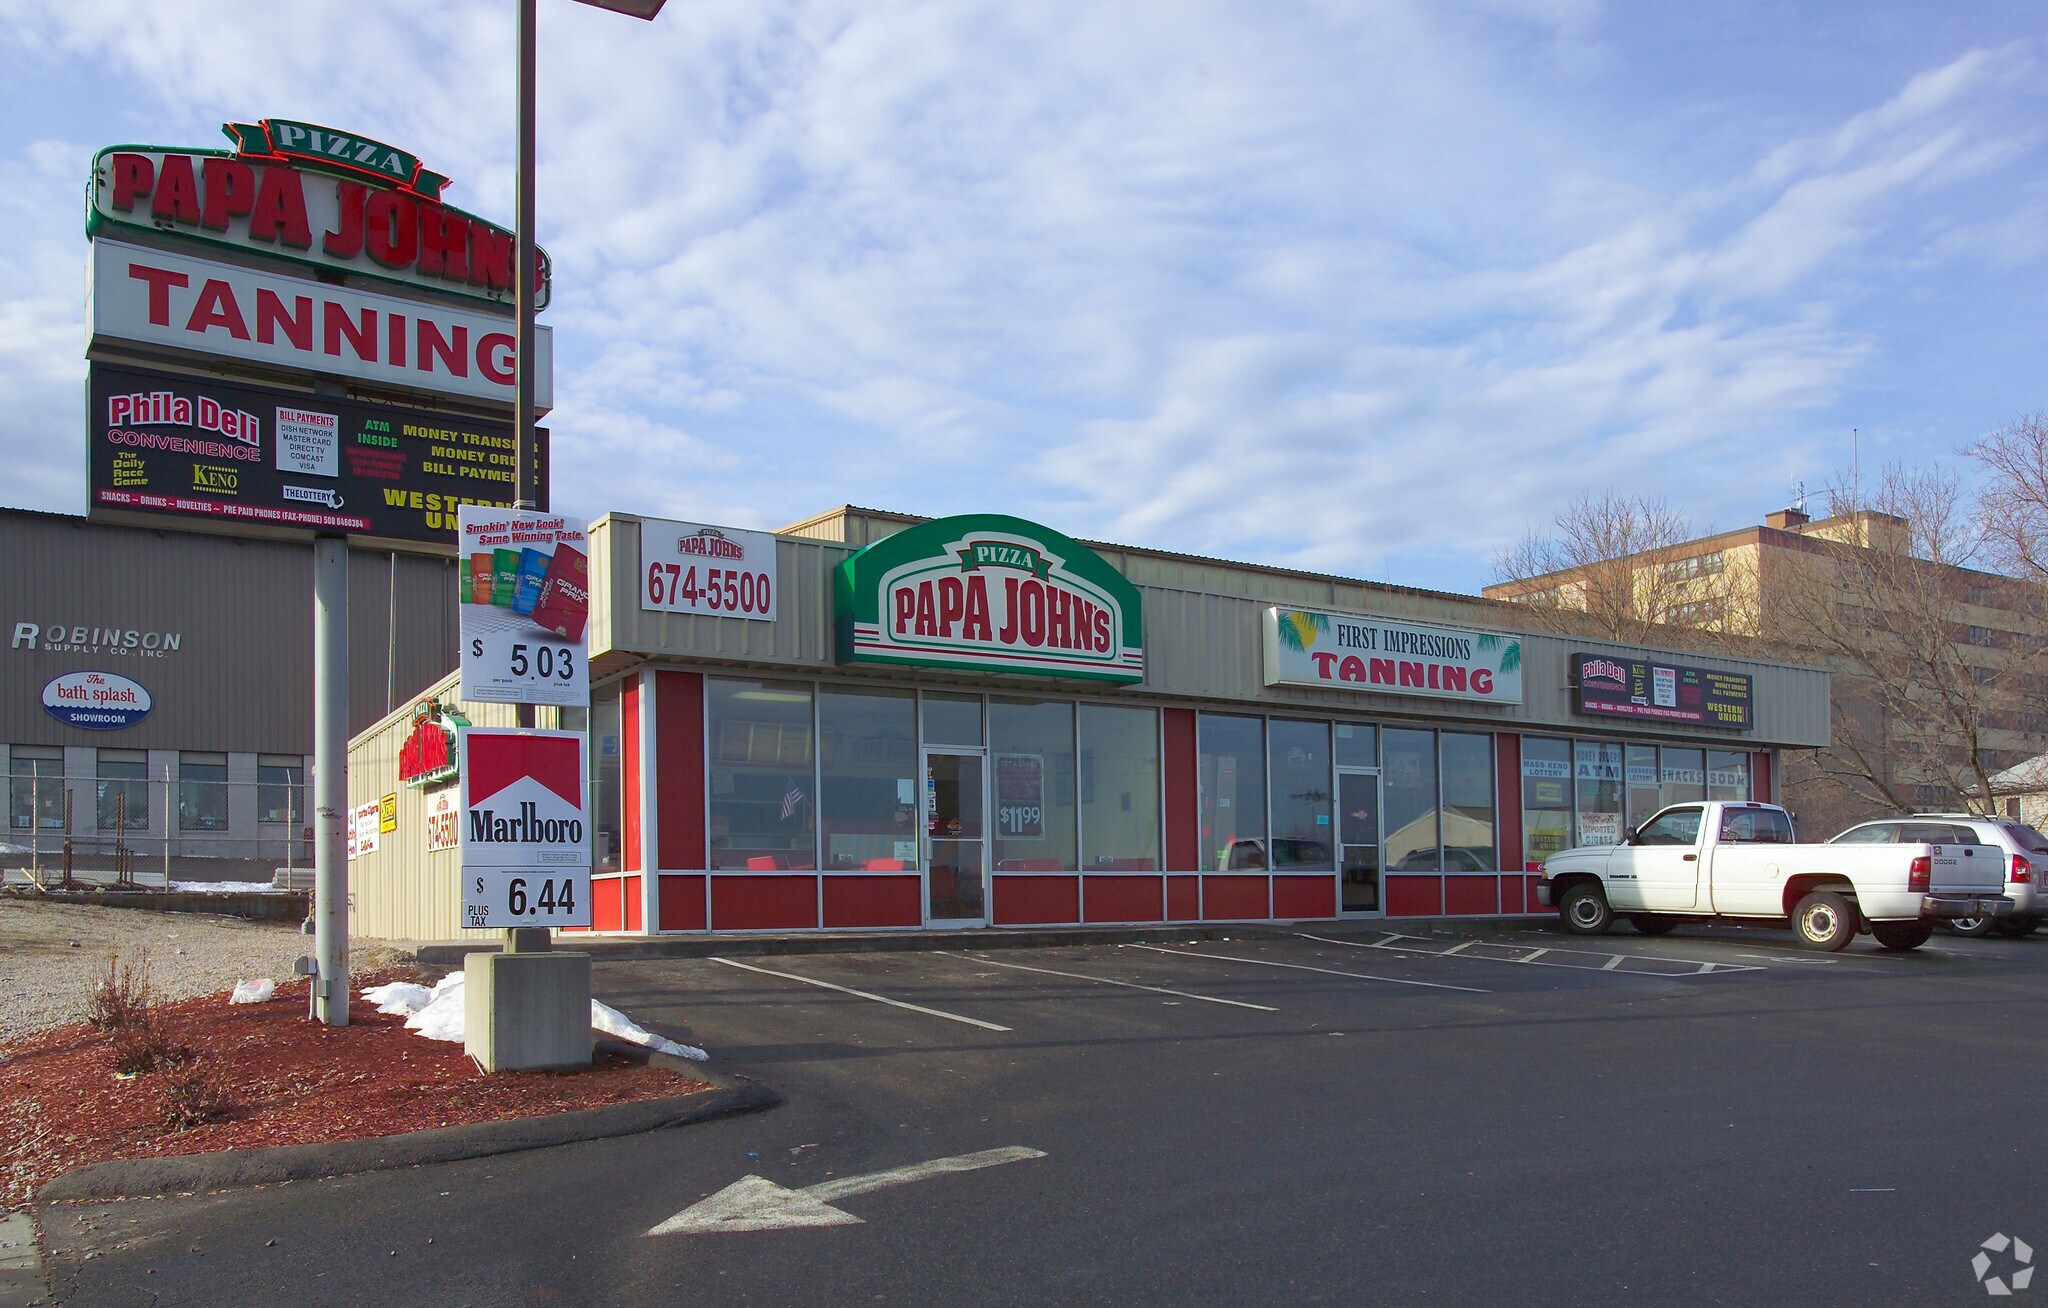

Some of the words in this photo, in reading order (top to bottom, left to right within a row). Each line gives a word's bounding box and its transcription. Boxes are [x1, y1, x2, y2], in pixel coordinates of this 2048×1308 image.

[278, 122, 405, 176] PIZZA
[112, 153, 312, 251] PAPA
[128, 263, 516, 385] TANNING
[109, 392, 192, 427] Phila
[198, 396, 260, 446] Deli
[280, 411, 295, 421] BILL
[297, 413, 334, 427] PAYMENTS
[365, 420, 390, 432] ATM
[281, 424, 298, 433] DISH
[299, 427, 333, 438] NETWORK
[403, 425, 459, 442] MONEY
[108, 428, 261, 462] CONVENIENCE
[283, 434, 311, 444] MASTER
[312, 437, 331, 446] CARD
[357, 433, 398, 448] INSIDE
[290, 443, 314, 453] DIRECT
[431, 446, 486, 462] MONEY
[113, 460, 145, 469] Daily
[290, 453, 324, 462] COMCAST
[113, 469, 144, 477] Race
[300, 462, 315, 470] VISA
[423, 462, 455, 476] BILL
[113, 478, 149, 487] Game
[193, 464, 238, 488] KENO
[101, 491, 130, 503] SNACKS
[140, 495, 167, 507] DRINKS
[176, 499, 212, 512] NOVELTIES
[223, 505, 236, 515] PRE
[238, 506, 253, 517] PAID
[255, 508, 281, 520] PHONES
[511, 520, 535, 532] New
[536, 518, 565, 530] Look!
[479, 534, 509, 546] Same
[512, 531, 553, 545] Winning
[680, 538, 707, 554] PAPA
[977, 546, 1034, 569] PIZZA
[560, 586, 583, 603] PRIX
[648, 561, 771, 615] 674-5500
[895, 575, 993, 641] PAPA
[1000, 577, 1110, 653] JOHN'S
[11, 622, 181, 651] ROBINSON
[1337, 624, 1378, 650] FIRST
[1383, 629, 1471, 661] IMPRESSIONS
[44, 642, 99, 654] SUPPLY
[140, 649, 168, 658] INC.
[472, 637, 483, 659] $
[510, 644, 574, 680] 5.03
[1311, 651, 1494, 695] TANNING
[1583, 660, 1606, 679] Phila
[86, 673, 105, 685] The
[57, 683, 90, 701] bath
[92, 687, 137, 706] splash
[1707, 702, 1742, 714] WESTERN
[70, 713, 126, 724] SHOWROOM
[1718, 712, 1743, 723] UNION
[1529, 769, 1563, 777] LOTTERY
[1547, 762, 1568, 770] KENO
[1578, 764, 1619, 778] ATM
[1661, 769, 1702, 783] SNACKS
[1710, 772, 1745, 786] SODA
[469, 801, 583, 844] Marlboro
[1934, 858, 1957, 866] DODGE
[476, 877, 484, 895] $
[508, 878, 575, 915] 6.44
[468, 905, 489, 916] PLUS
[470, 915, 486, 927] TAX
